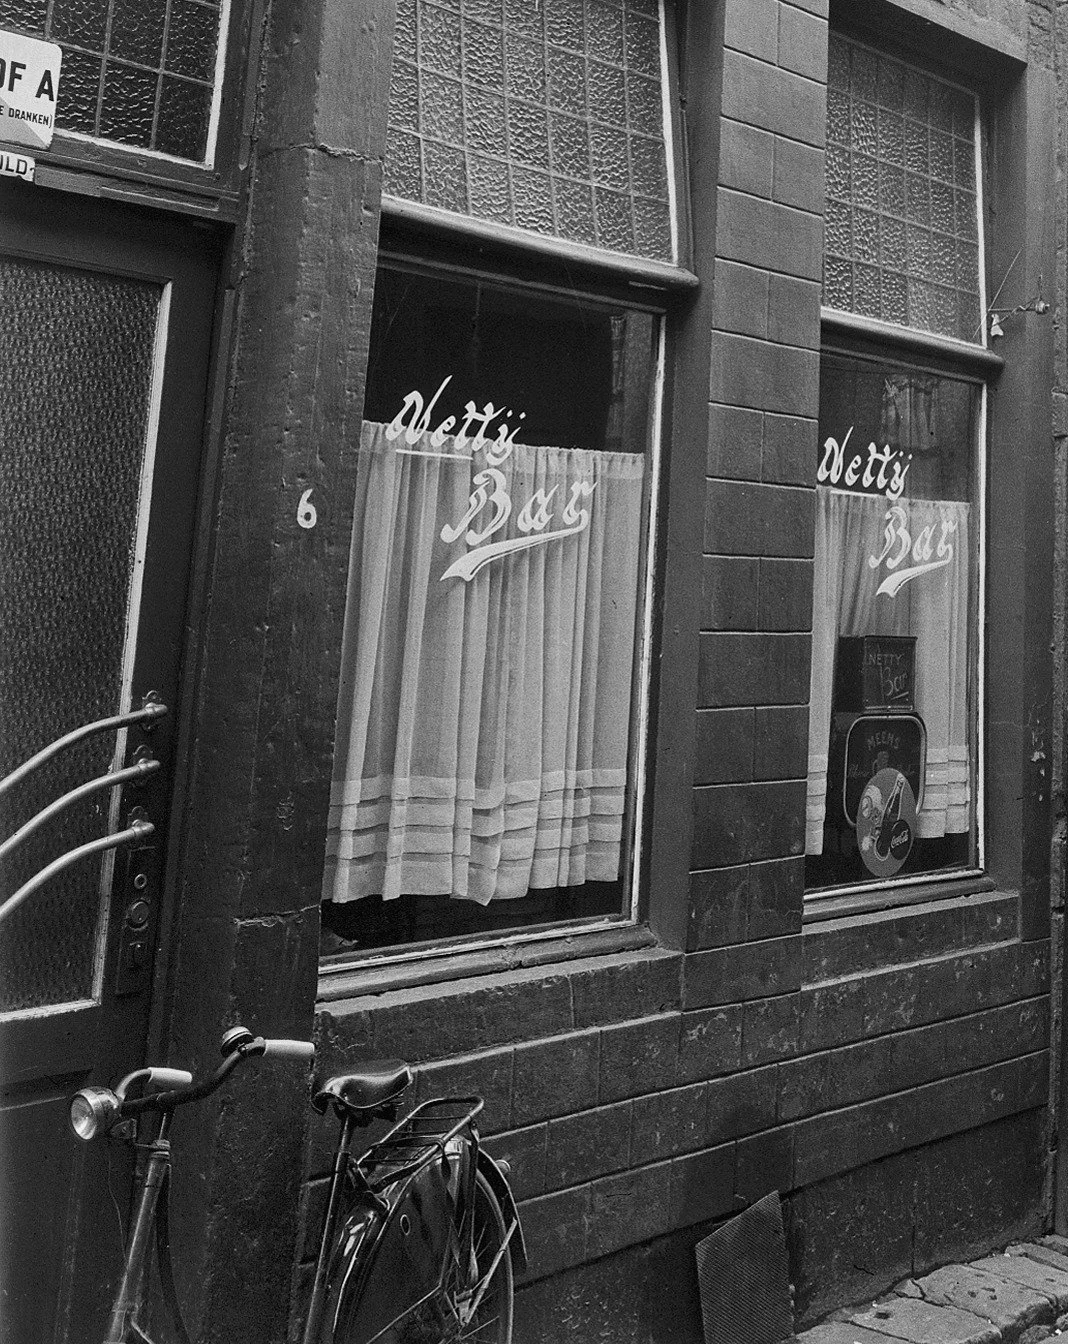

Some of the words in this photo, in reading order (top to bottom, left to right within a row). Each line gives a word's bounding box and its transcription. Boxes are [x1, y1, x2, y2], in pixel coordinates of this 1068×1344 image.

[35, 69, 55, 102] A
[8, 107, 53, 129] DRANKEN)
[296, 488, 318, 530] 6
[440, 468, 598, 581] Bar
[868, 506, 958, 598] Bar
[868, 653, 905, 667] NETTY
